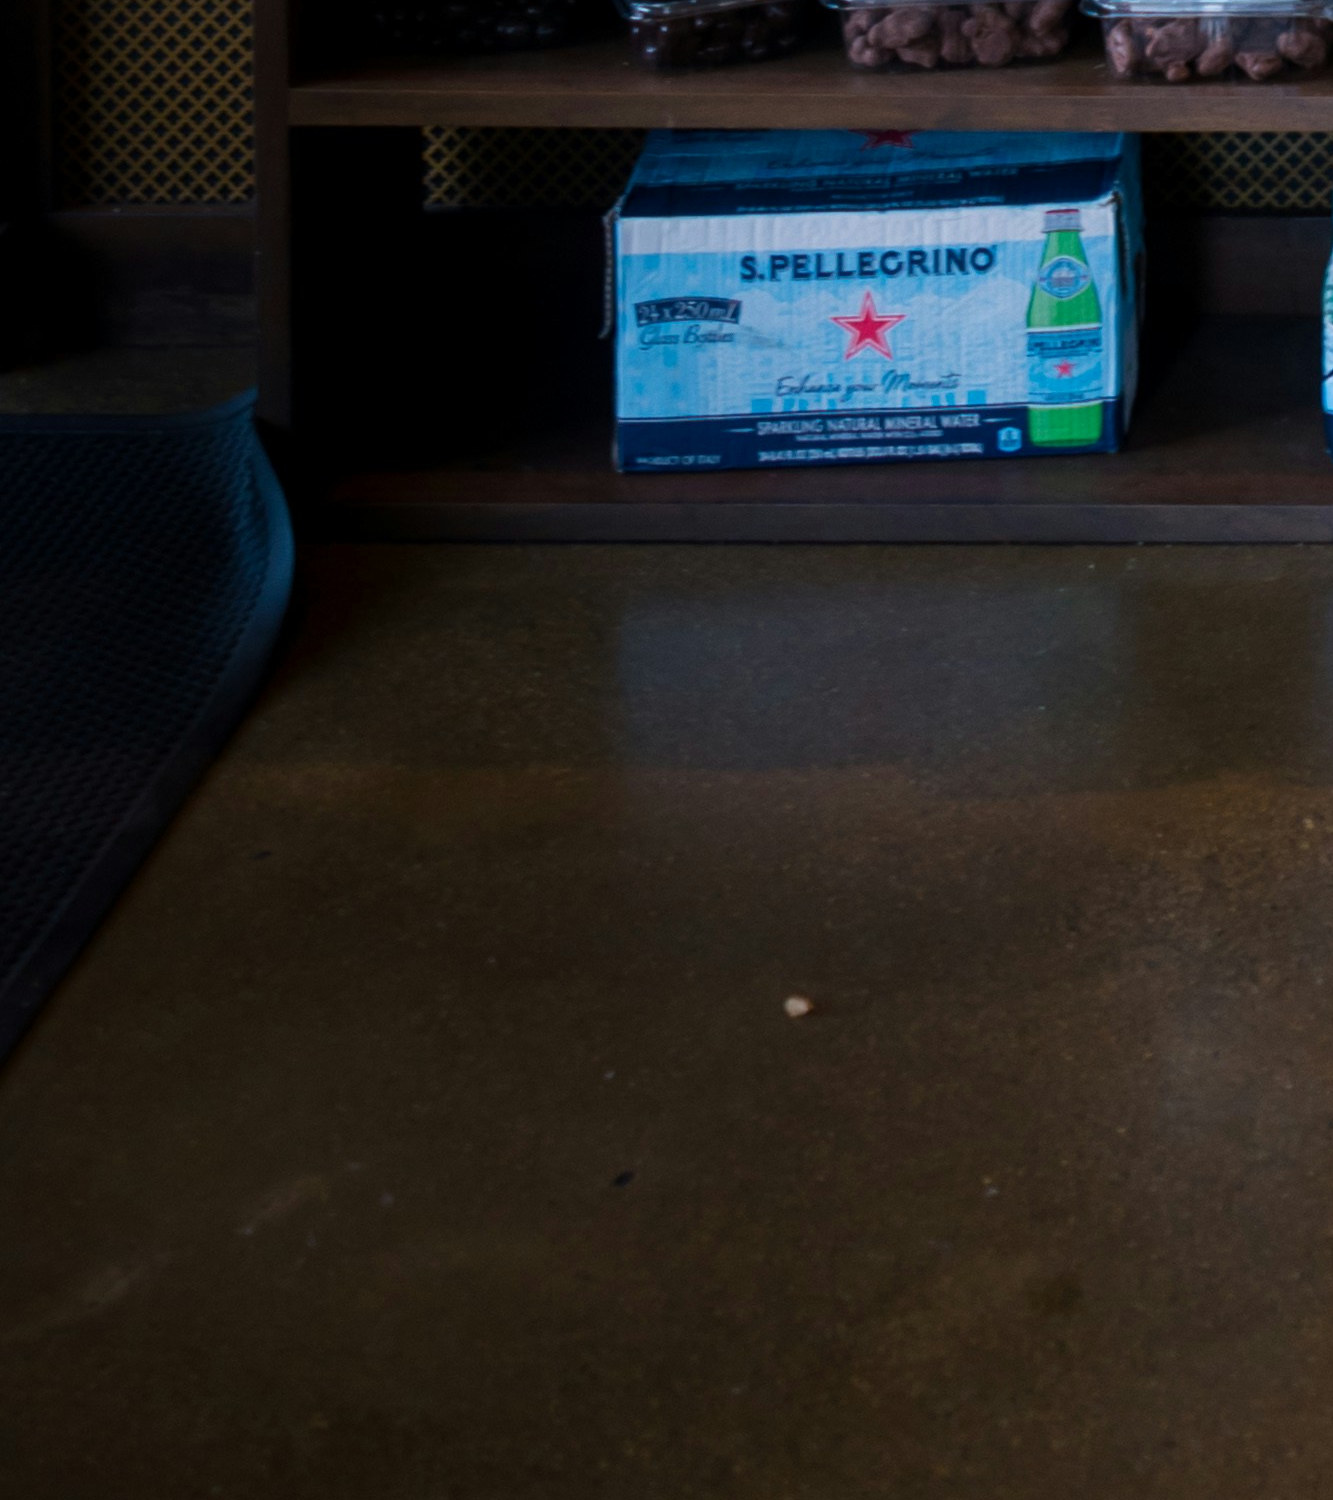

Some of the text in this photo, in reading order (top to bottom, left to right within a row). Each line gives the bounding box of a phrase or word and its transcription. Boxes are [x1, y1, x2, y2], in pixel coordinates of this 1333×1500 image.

[739, 248, 994, 282] S.PELLEGRINO
[775, 369, 961, 402] Enhance your Moments
[757, 414, 981, 435] SPARKLING NATURAL MINERAL WATER
